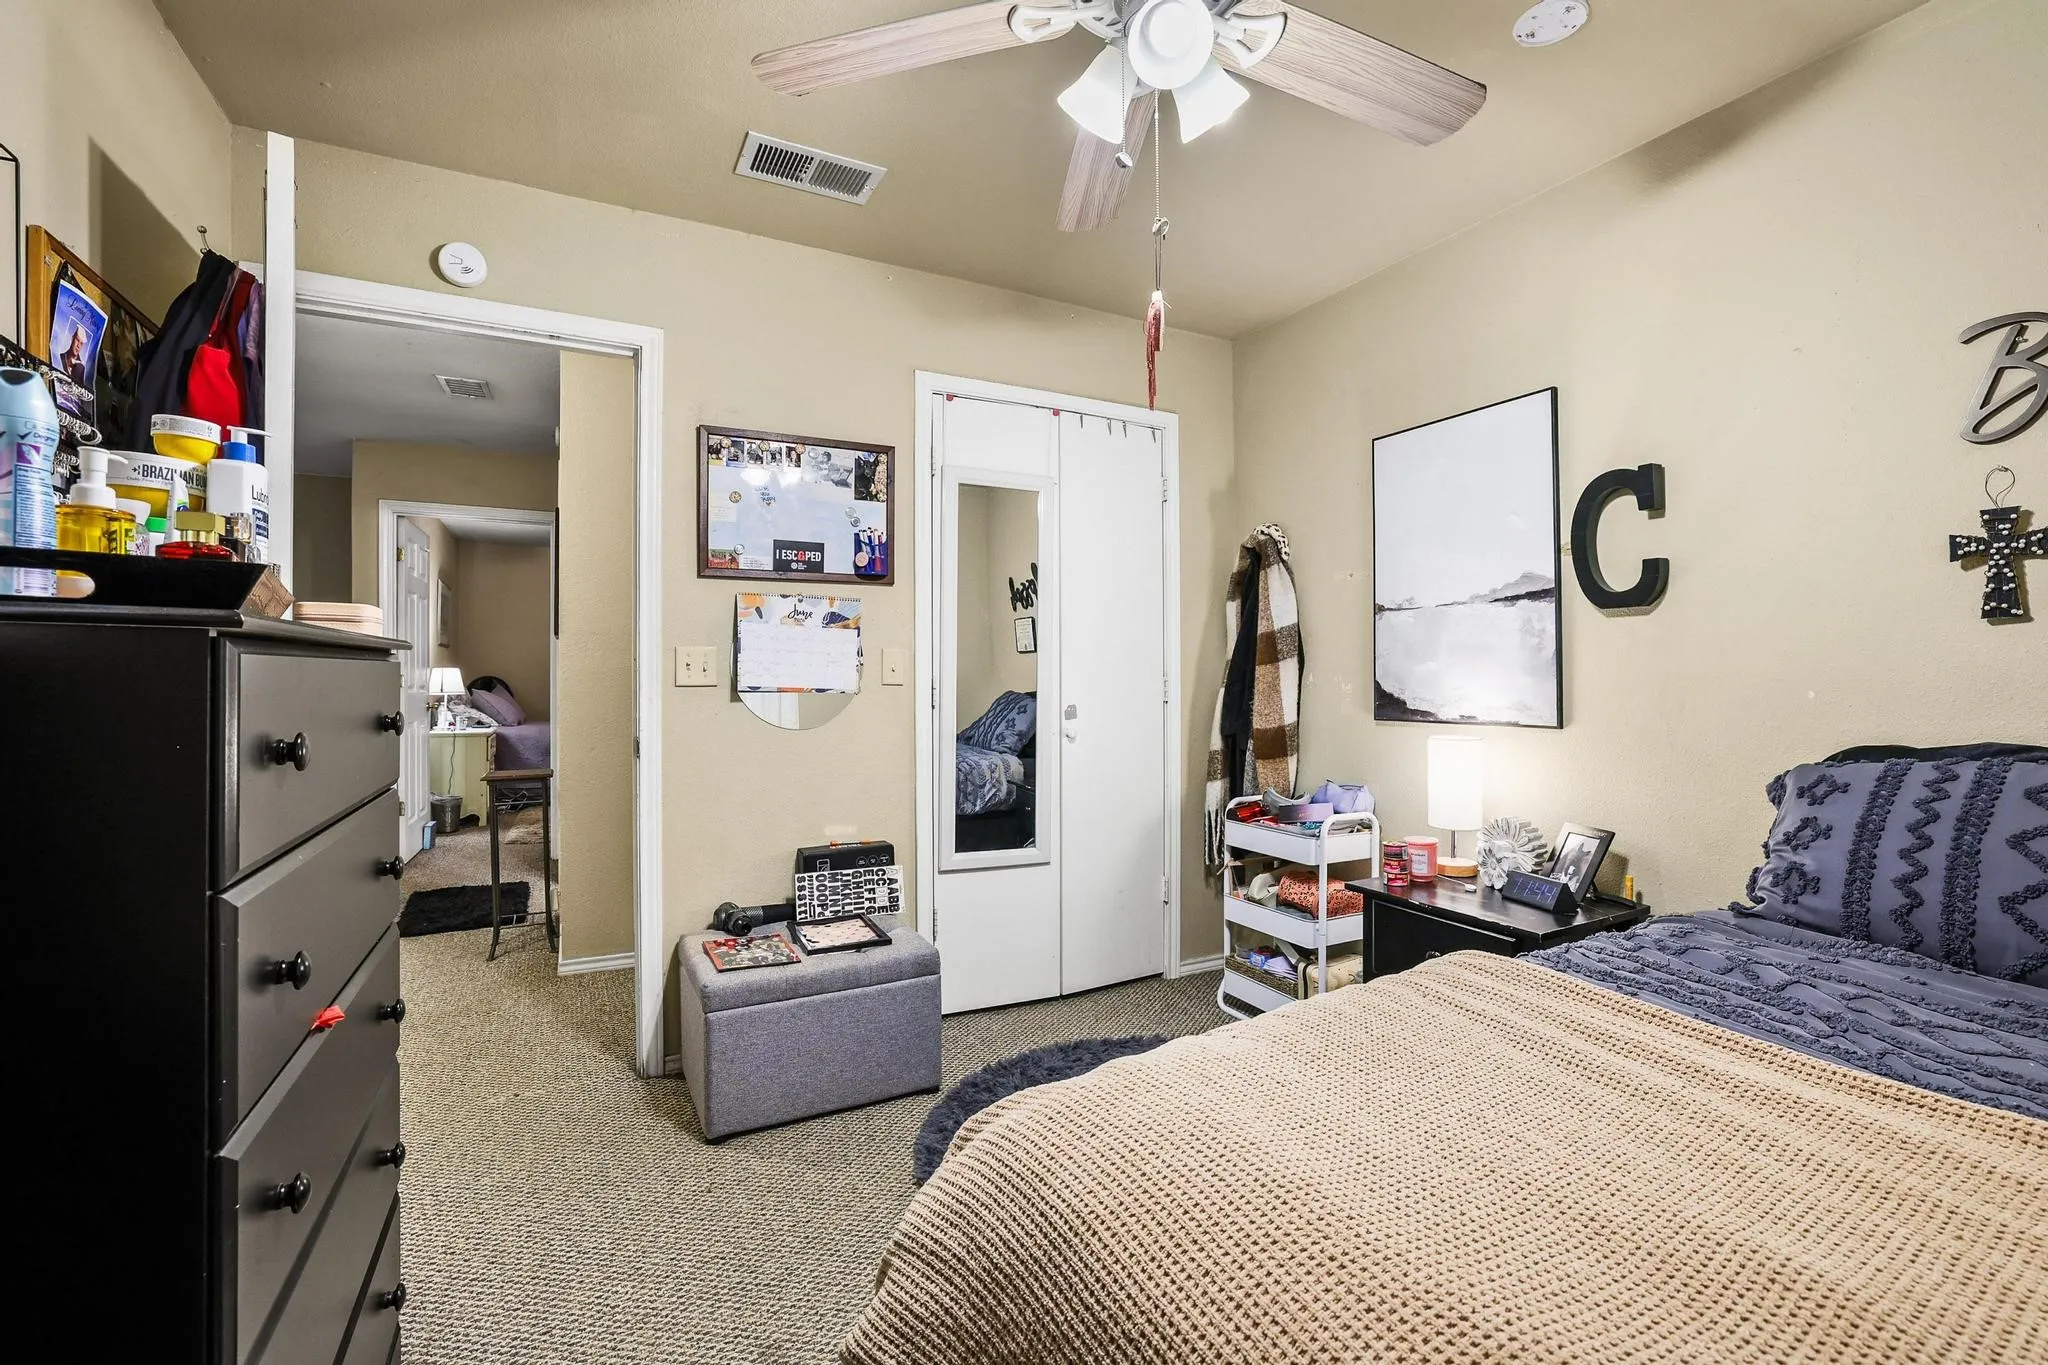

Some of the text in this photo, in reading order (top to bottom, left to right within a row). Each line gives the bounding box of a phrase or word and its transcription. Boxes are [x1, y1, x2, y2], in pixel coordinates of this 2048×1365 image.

[1958, 311, 2048, 445] B
[142, 464, 194, 485] BRAZIIAN
[1571, 463, 1669, 612] C
[788, 603, 813, 620] June
[1513, 877, 1557, 904] 11:44
